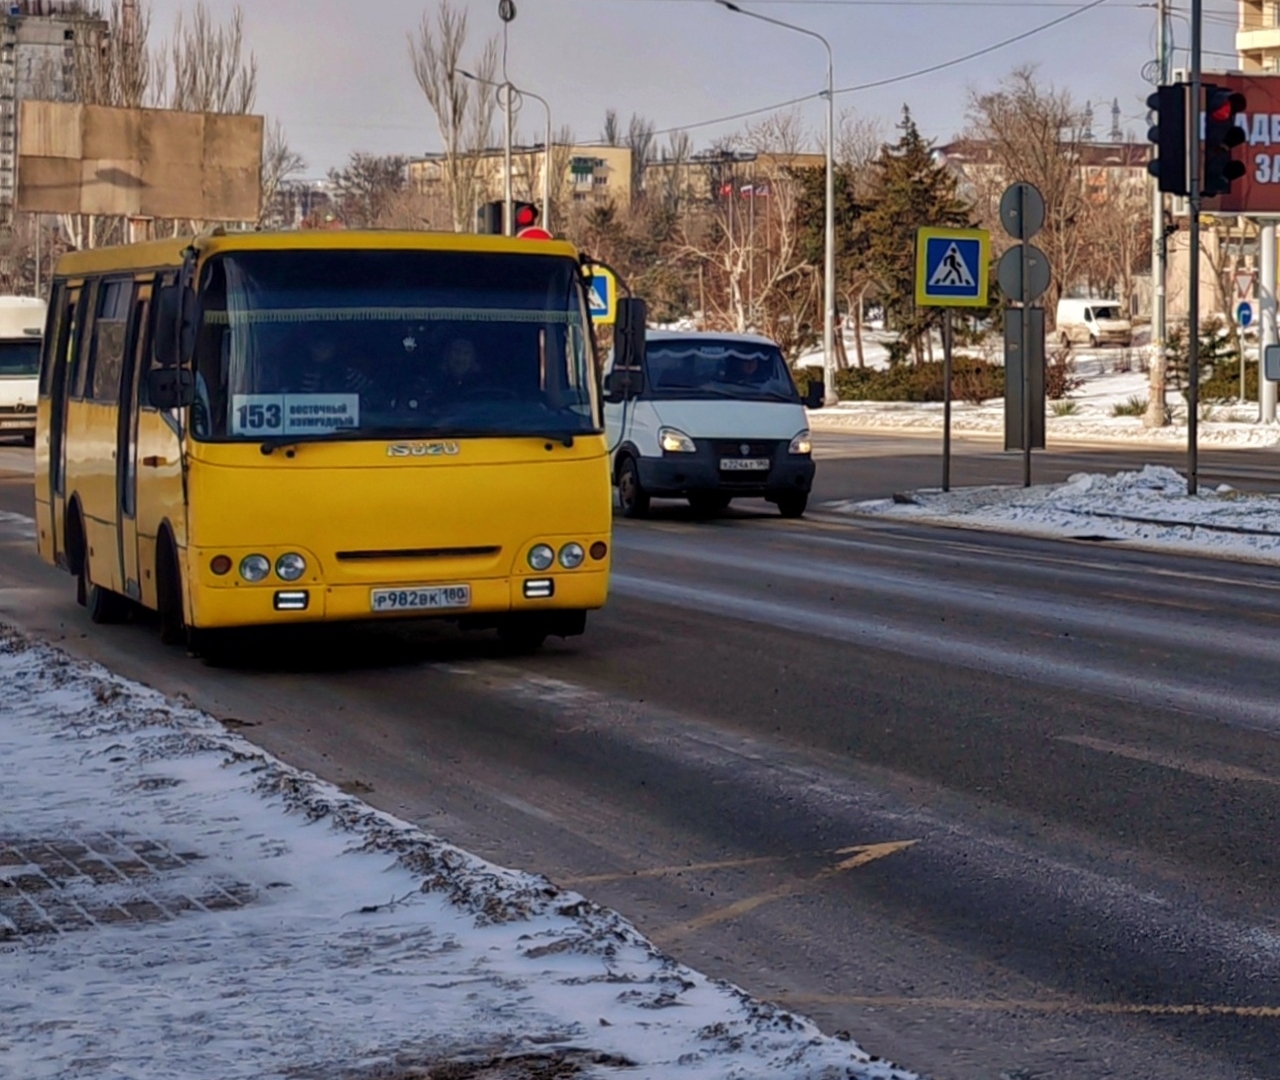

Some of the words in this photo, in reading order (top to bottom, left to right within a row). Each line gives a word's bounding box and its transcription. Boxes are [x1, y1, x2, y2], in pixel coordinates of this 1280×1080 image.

[237, 404, 281, 429] 153
[387, 441, 459, 457] ISUZU
[377, 591, 439, 607] Р982ВК
